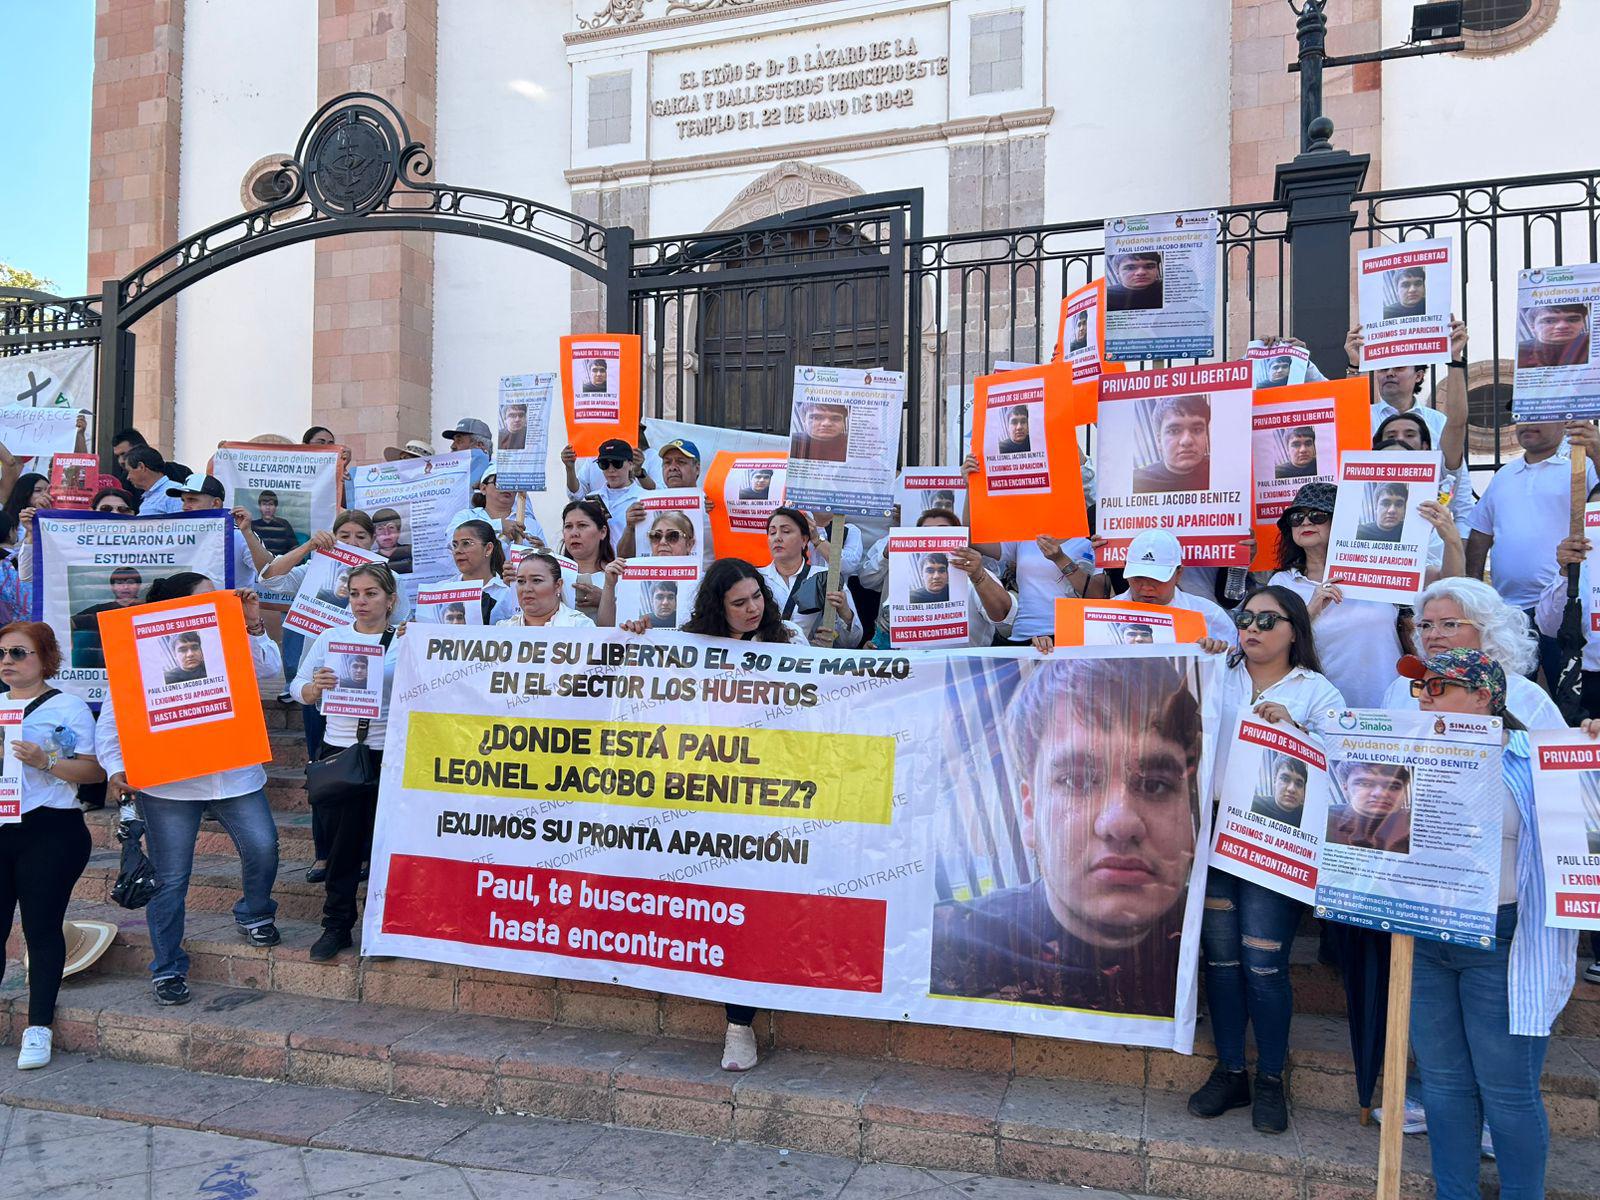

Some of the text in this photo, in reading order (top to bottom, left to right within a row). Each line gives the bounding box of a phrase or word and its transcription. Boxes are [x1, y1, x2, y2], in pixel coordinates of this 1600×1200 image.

[680, 71, 699, 90] EL
[746, 61, 761, 80] Sr
[767, 59, 784, 78] Dr
[869, 40, 892, 61] DE
[895, 37, 918, 57] LA
[652, 56, 948, 117] GARZA Y BALLESTEROS PRINCIPIO ESTE
[676, 114, 735, 140] TEMPLO
[762, 108, 780, 127] 22
[785, 104, 805, 124] DE
[808, 98, 848, 121] MAYO
[852, 93, 872, 115] DE
[875, 88, 913, 112] 1842
[1127, 224, 1149, 232] Sinaloa
[1365, 261, 1391, 270] PRIVADO
[1414, 251, 1445, 262] LIBERTAD
[1369, 342, 1440, 356] HASTA ENCONTRARTE
[1102, 366, 1248, 394] PRIVADO DE SU LIBERTAD
[1254, 410, 1334, 426] PRIVADO DE SU LIBERTAD
[238, 462, 316, 474] SE LLEVARON A UN
[1346, 467, 1433, 477] PRIVADO DE SU LIBERTAD
[249, 478, 301, 489] ESTUDIANTE
[991, 477, 1046, 488] HASTA ENCONTRARTE
[366, 488, 450, 505] RICARDO LECHUGA VERDUGO
[1101, 491, 1241, 509] PAUL LEONEL JACOBO BENITEZ
[42, 522, 59, 532] No
[61, 524, 76, 532] se
[79, 522, 126, 533] llevaron
[140, 524, 153, 532] un
[156, 522, 223, 533] delincuente
[1110, 516, 1157, 530] EXIGIMOS
[1161, 515, 1174, 528] SU
[1177, 513, 1234, 527] APARICION
[77, 535, 195, 545] SE LLEVARON A UN
[891, 539, 968, 548] PRIVADO DE SU LIBERTAD
[94, 554, 175, 564] ESTUDIANTE
[1333, 571, 1411, 586] HASTA ENCONTRARTE
[137, 616, 216, 635] PRIVADO DE SU LIBERTAD
[895, 626, 964, 639] HASTA ENCONTRARTE
[427, 639, 911, 680] PRIVADO DE SU LIBERTAD EL 30 DE MARZO
[88, 688, 102, 698] 28
[489, 671, 819, 708] EN EL SECTOR LOS HUERTOS
[154, 702, 227, 722] HASTA ENCONTRARTE
[1360, 722, 1392, 731] Sinaloa
[1449, 723, 1488, 731] SINALOA
[478, 723, 760, 765] ¿DONDE ESTÁ PAUL
[1342, 738, 1400, 751] Ayúdanos
[1415, 746, 1475, 758] encontrar
[1479, 751, 1487, 759] a
[1347, 752, 1479, 770] PAUL LEONEL JACOBO BENITEZ
[1543, 751, 1593, 763] PRIVADO
[434, 757, 818, 810] LEONEL JACOBO BENITEZ?
[1227, 806, 1318, 845] PAUL LEONEL JACOBO BENITEZ
[541, 818, 573, 844] SU
[577, 821, 663, 853] PRONTA
[1230, 822, 1312, 858] EXIGIMOS SU APARICION
[1221, 840, 1248, 859] HASTA
[1249, 850, 1310, 882] ENCONTRARTE
[1557, 855, 1580, 865] PAUL
[476, 869, 745, 927] Paul, te buscaremos
[1329, 889, 1349, 899] tienes
[1352, 893, 1392, 906] información
[1395, 902, 1429, 912] referente
[1440, 909, 1457, 917] esta
[1319, 895, 1337, 904] llama
[1386, 906, 1394, 914] Tu
[1396, 909, 1418, 920] ayuda
[1431, 915, 1447, 924] muy
[488, 911, 725, 968] hasta encontrarte
